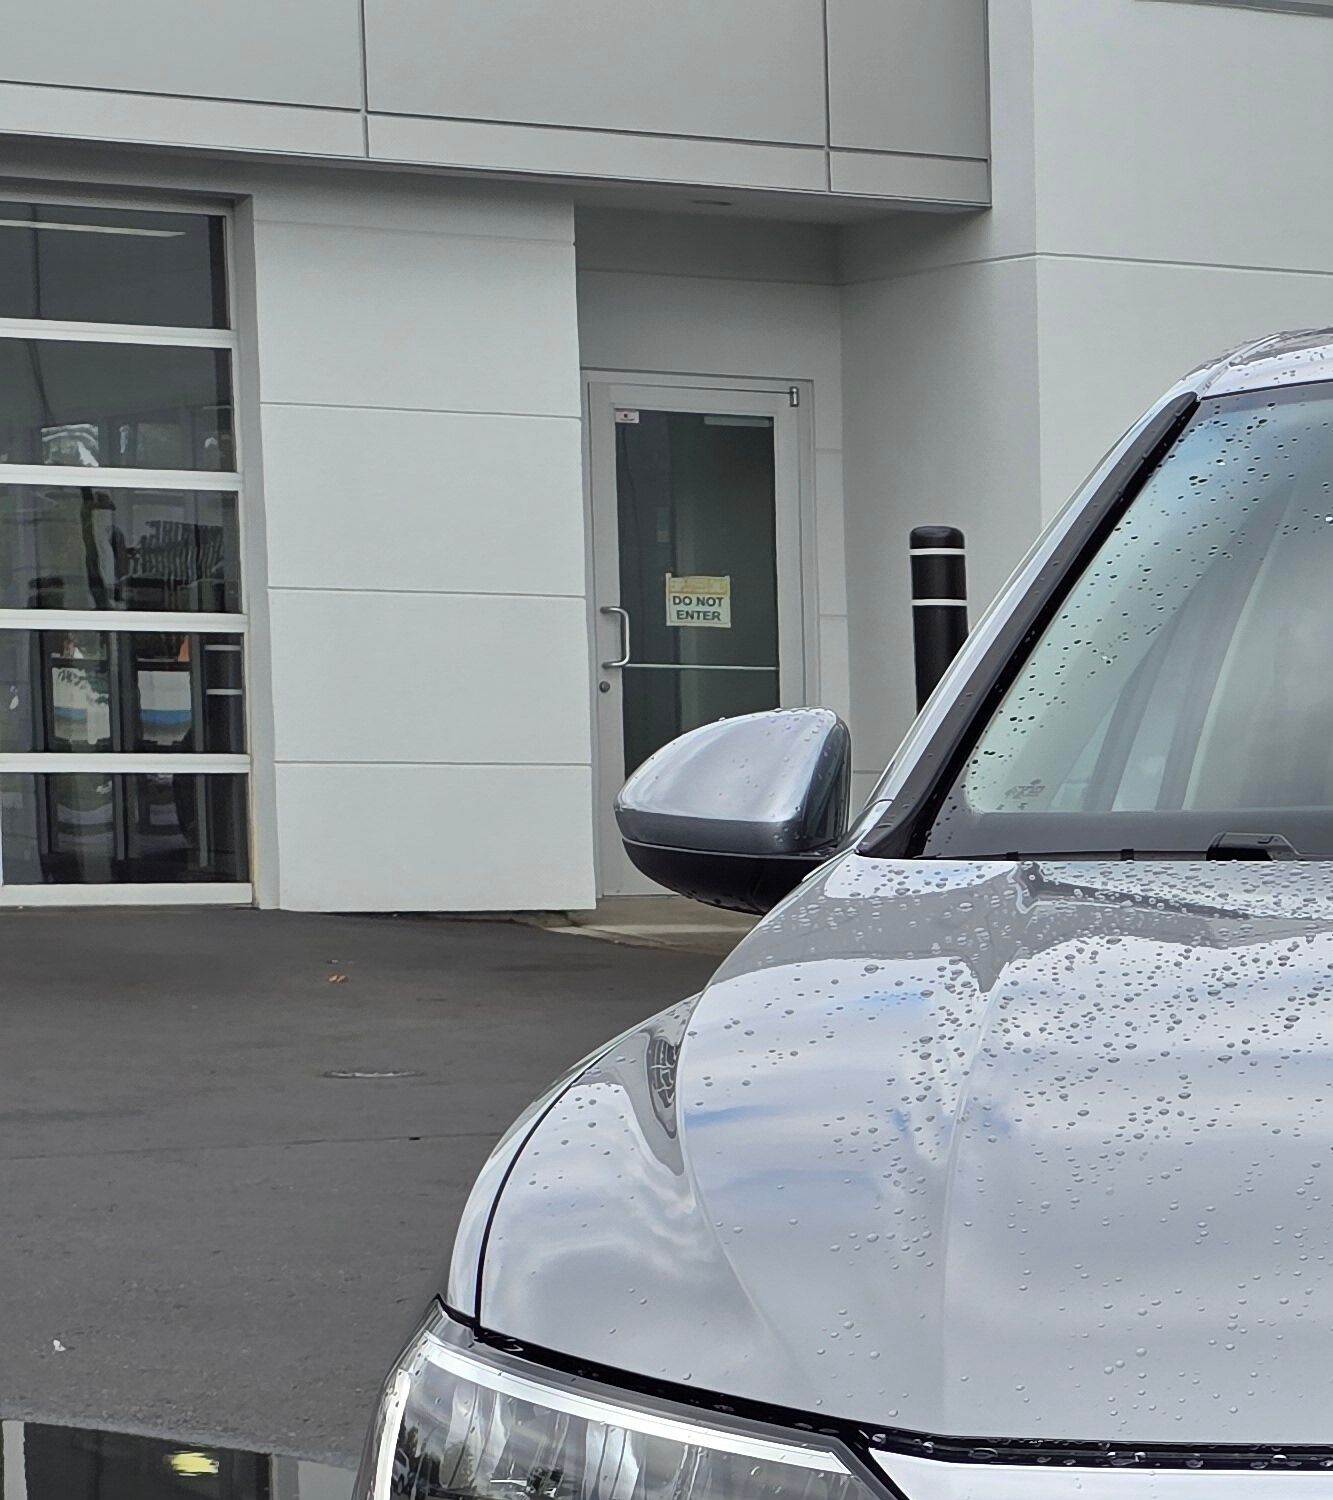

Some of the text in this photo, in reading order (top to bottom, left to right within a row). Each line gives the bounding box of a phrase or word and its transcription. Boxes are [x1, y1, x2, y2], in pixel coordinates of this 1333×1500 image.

[672, 595, 724, 608] DO NOT
[676, 609, 721, 622] ENTER
